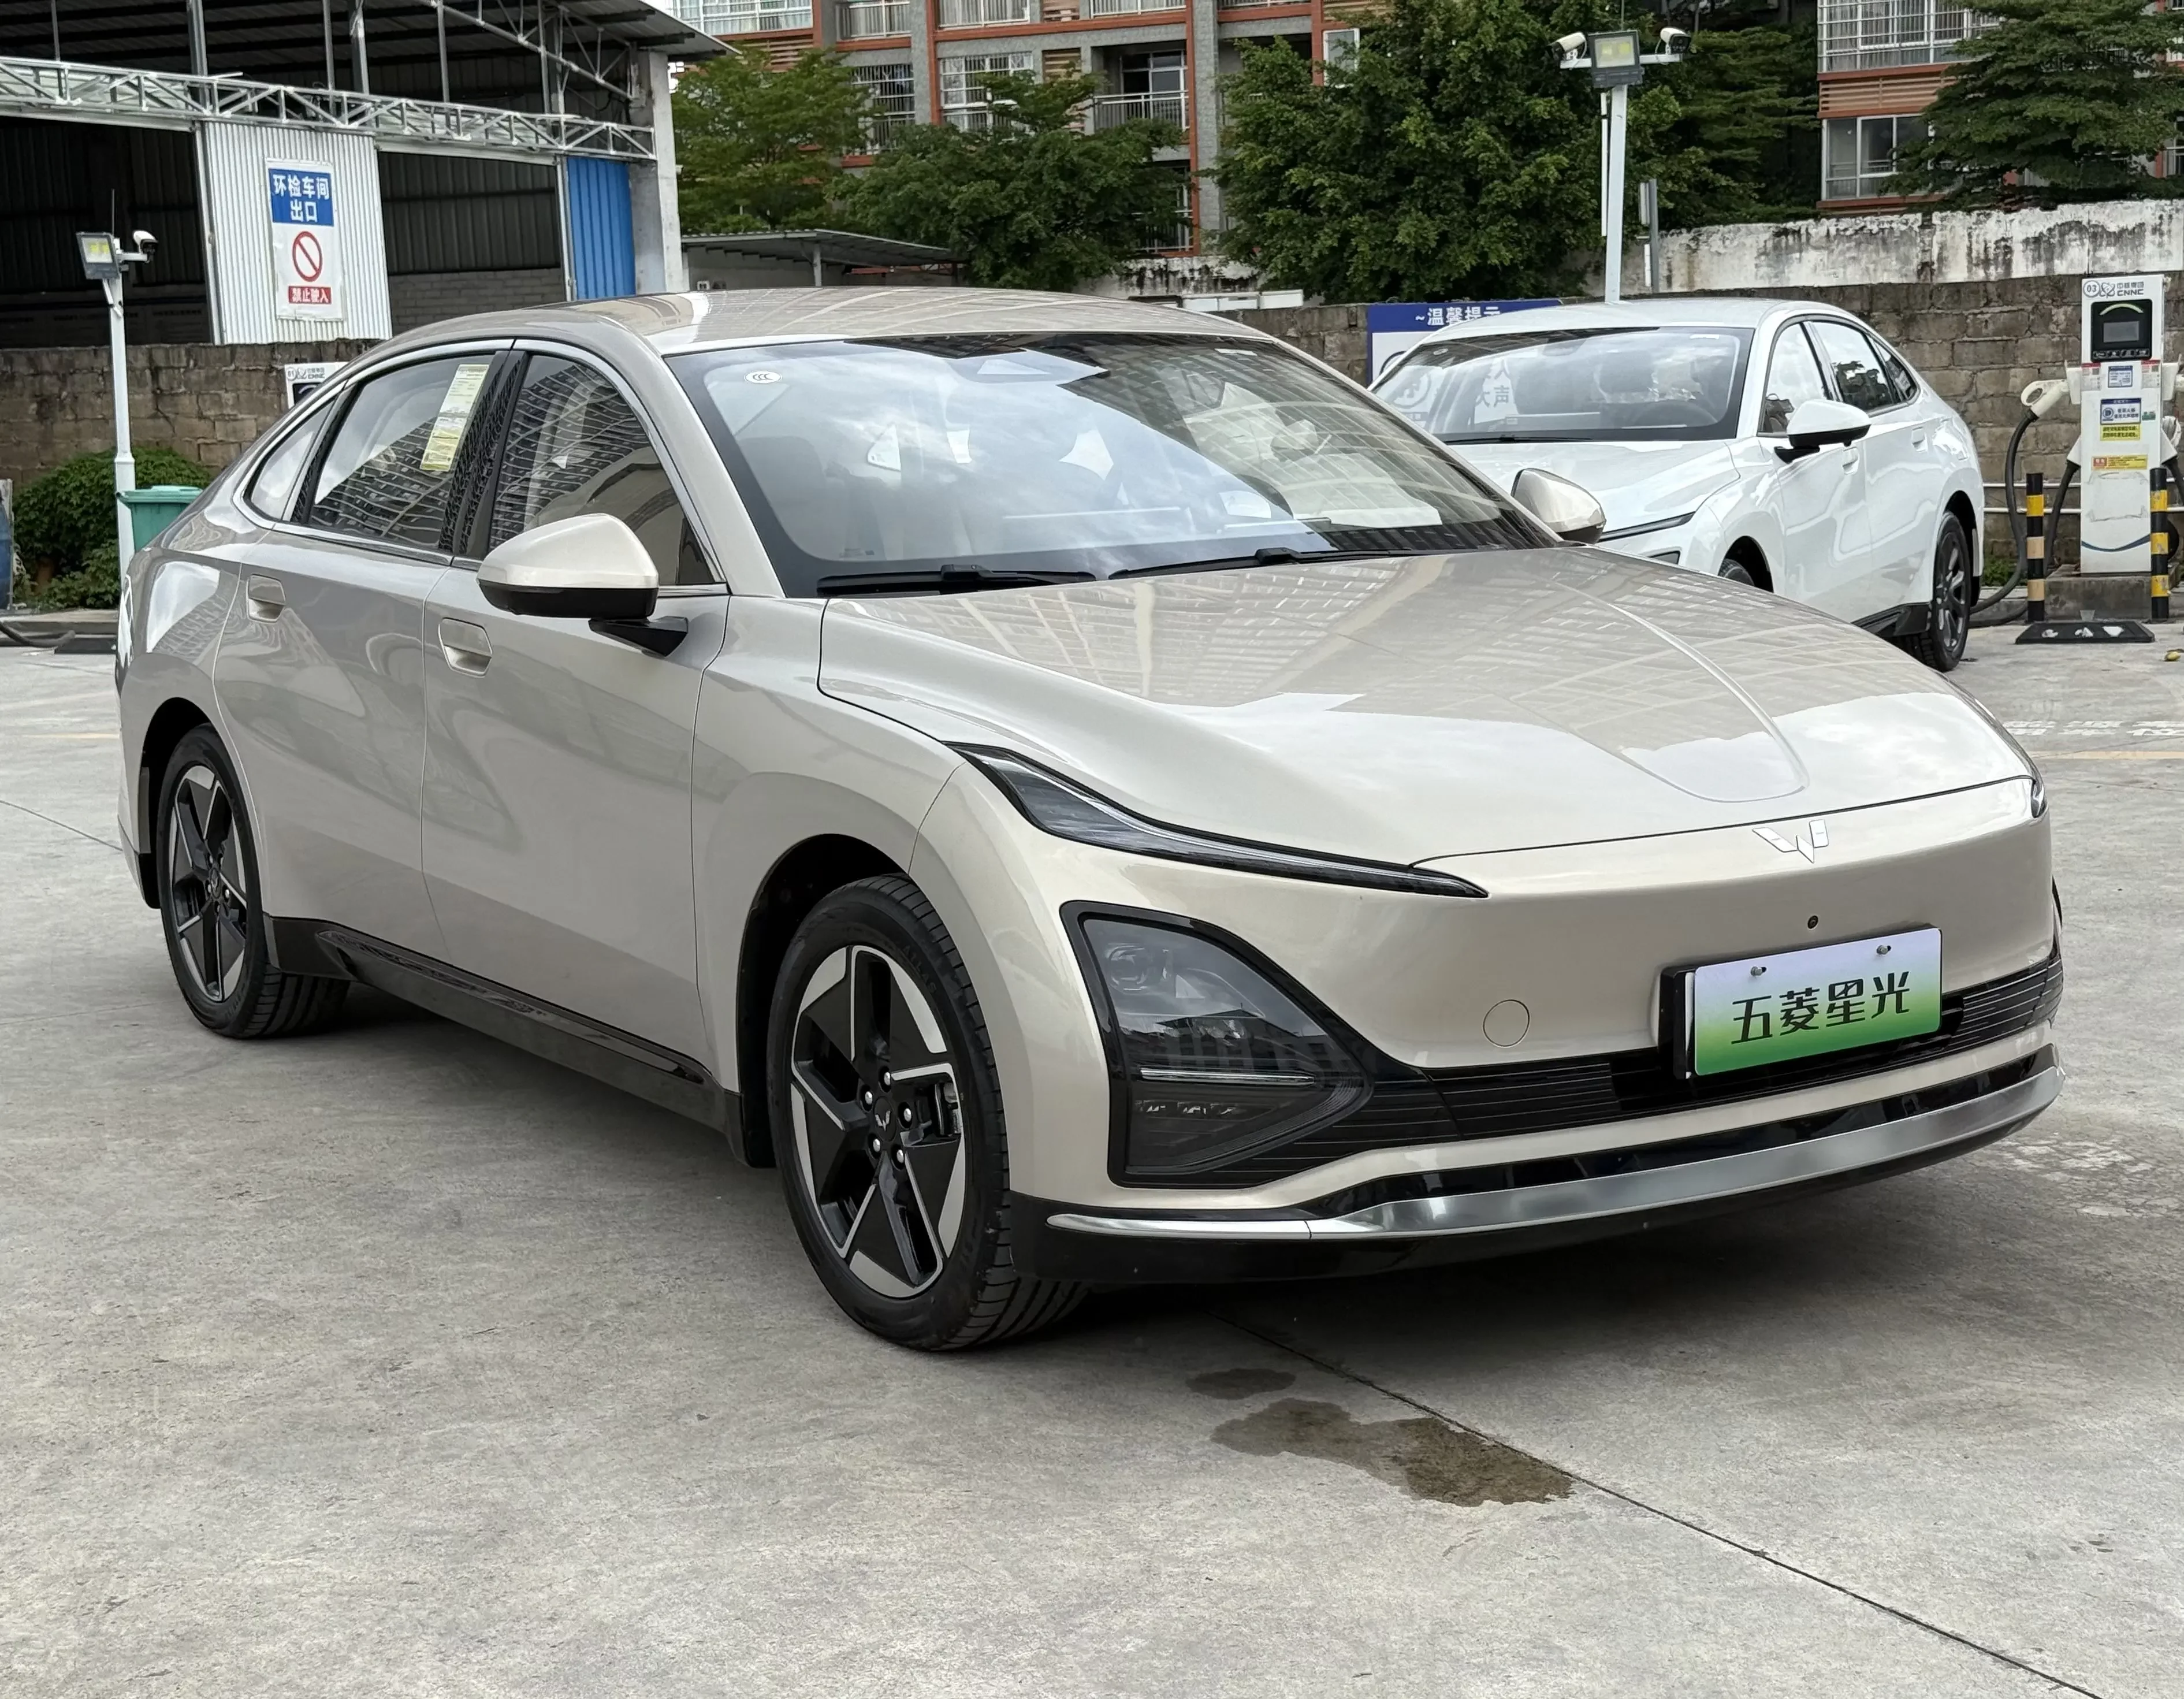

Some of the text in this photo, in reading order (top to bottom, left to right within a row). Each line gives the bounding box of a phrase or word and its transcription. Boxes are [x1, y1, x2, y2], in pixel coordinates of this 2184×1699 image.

[272, 173, 330, 200] 环检车间
[289, 200, 318, 223] 出口
[2086, 284, 2097, 293] 03
[1731, 971, 1910, 1045] 五菱星光
